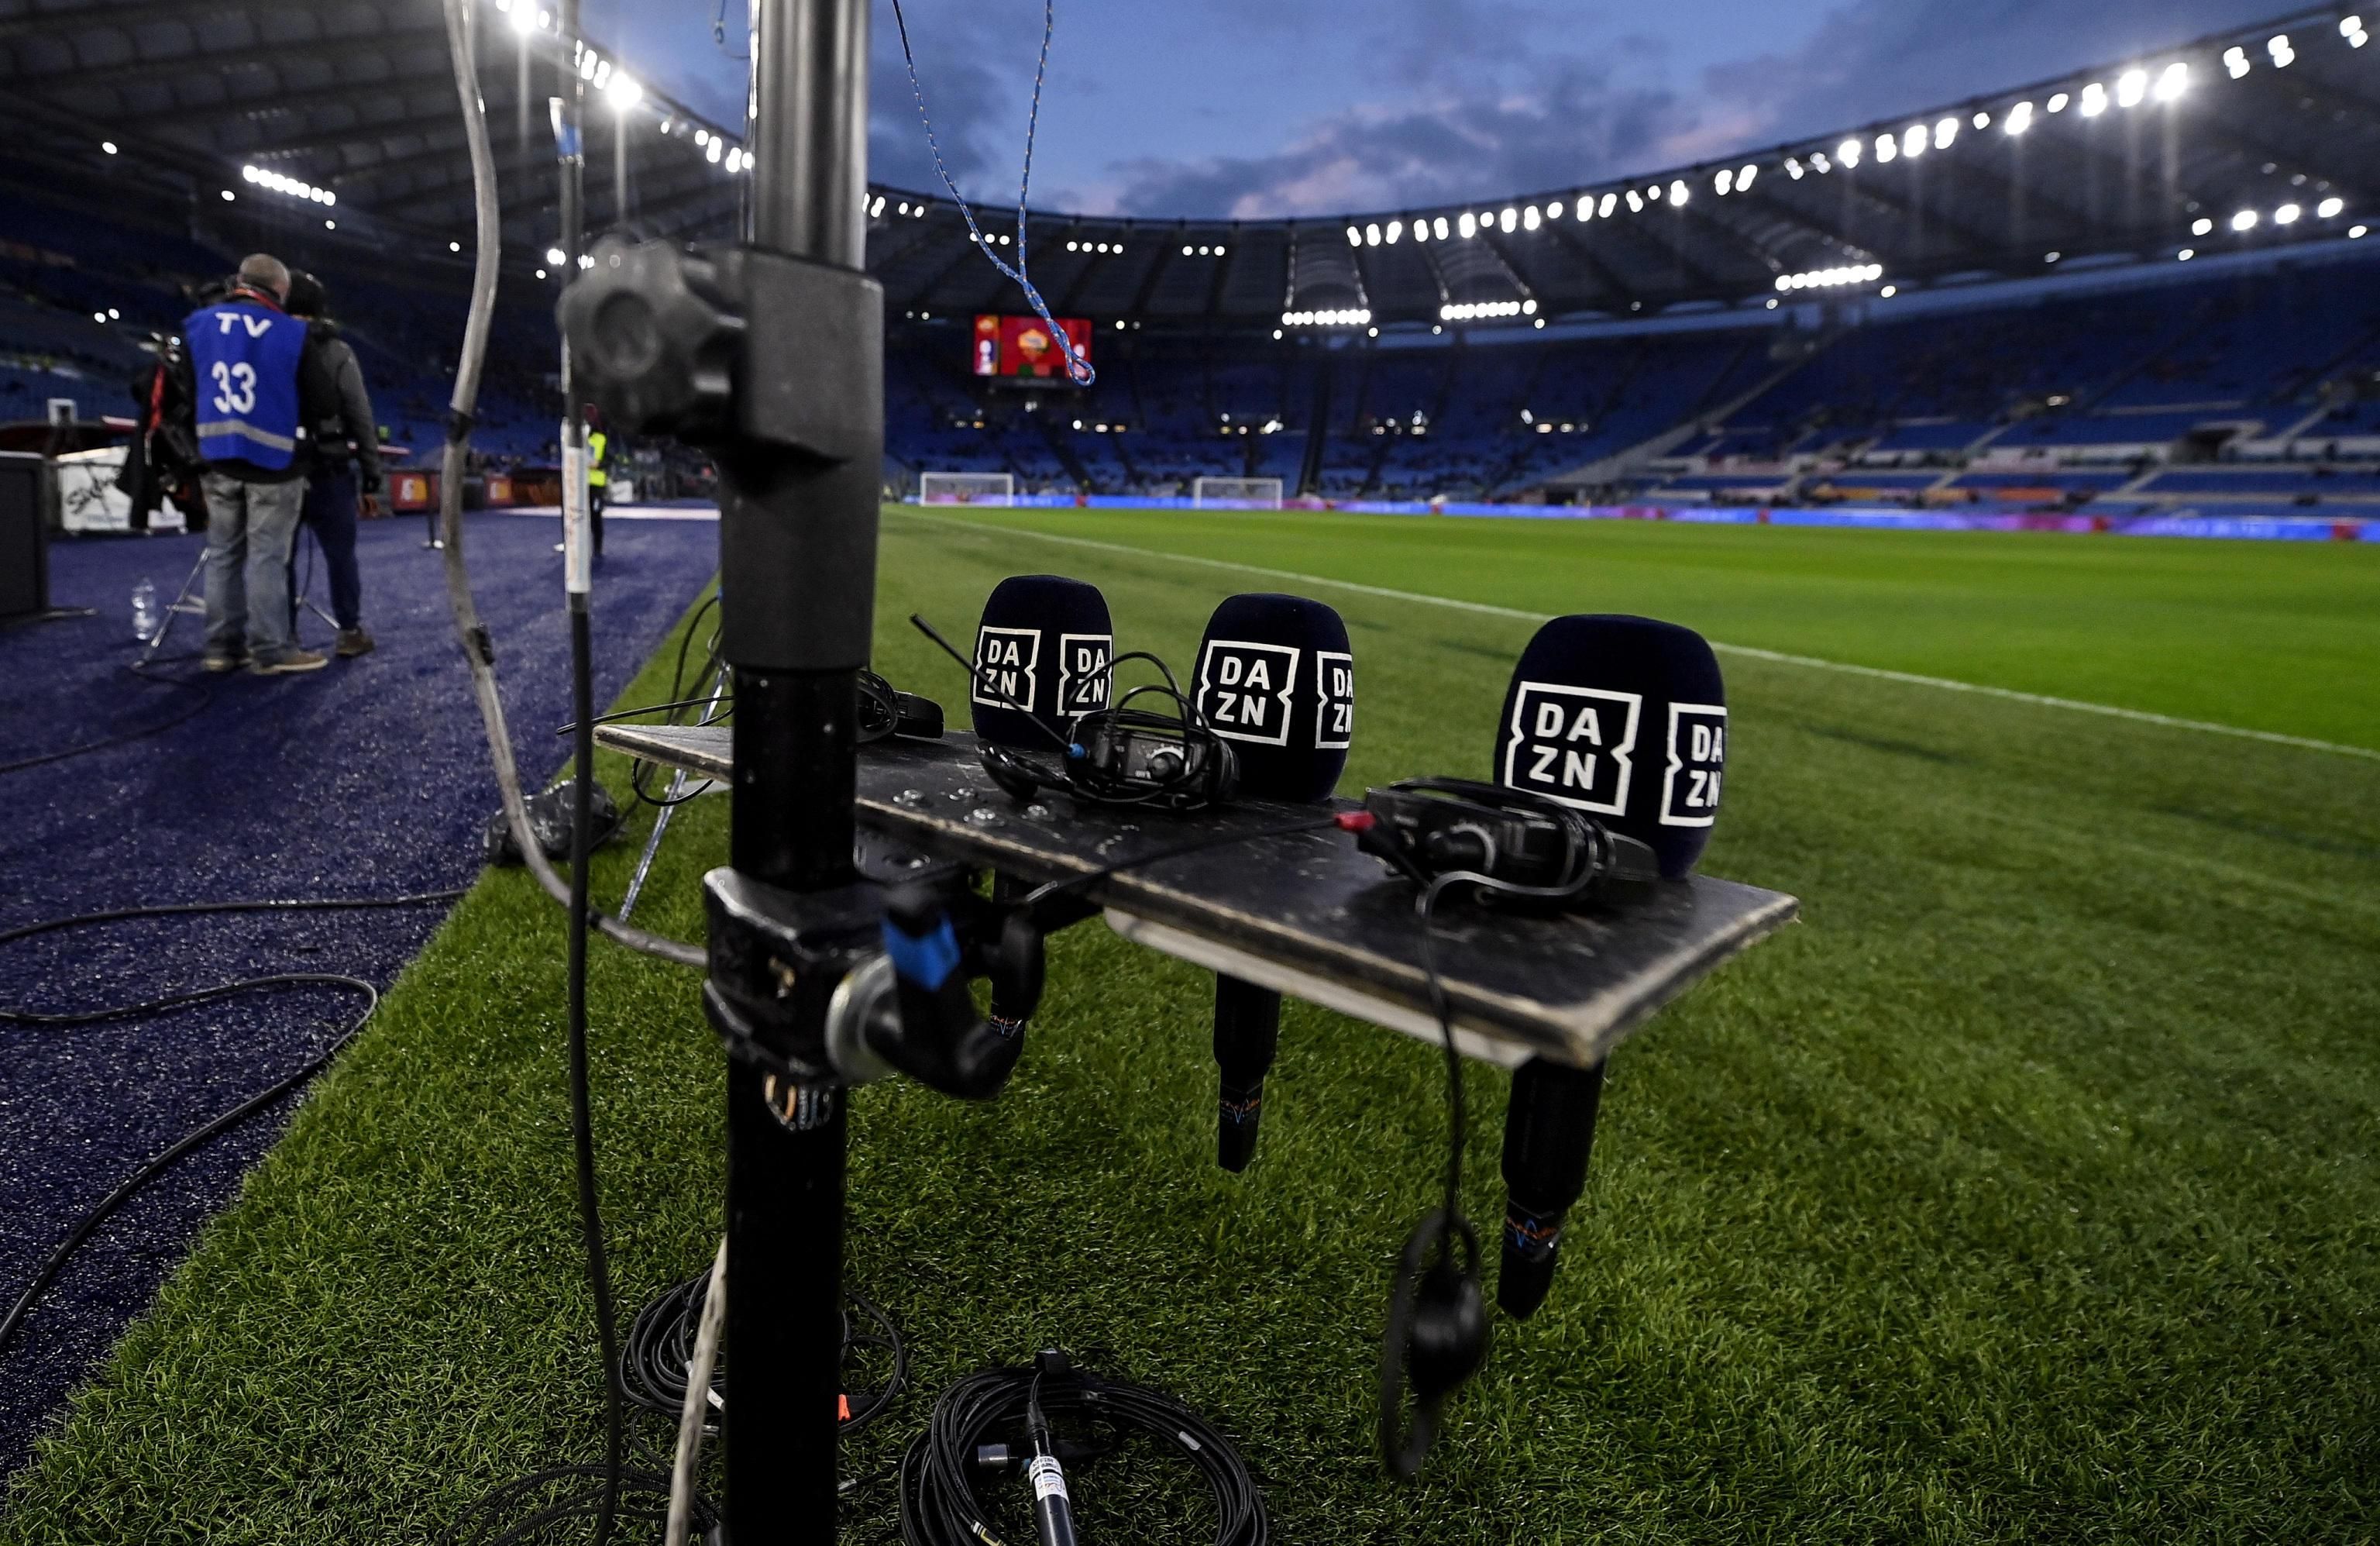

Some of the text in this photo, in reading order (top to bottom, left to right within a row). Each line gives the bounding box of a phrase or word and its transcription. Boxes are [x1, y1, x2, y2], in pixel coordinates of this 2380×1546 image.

[215, 312, 273, 338] TV
[212, 360, 256, 414] 33
[988, 639, 1020, 666] DA
[1078, 648, 1106, 673] DA
[983, 668, 1017, 697] ZN
[1219, 656, 1271, 690] DA
[1333, 667, 1353, 697] DA
[1076, 678, 1105, 703] ZN
[1215, 691, 1267, 726] ZN
[1535, 702, 1602, 745] DA
[1691, 724, 1723, 763] DA
[1529, 745, 1597, 790] ZN
[1685, 770, 1721, 807] ZN
